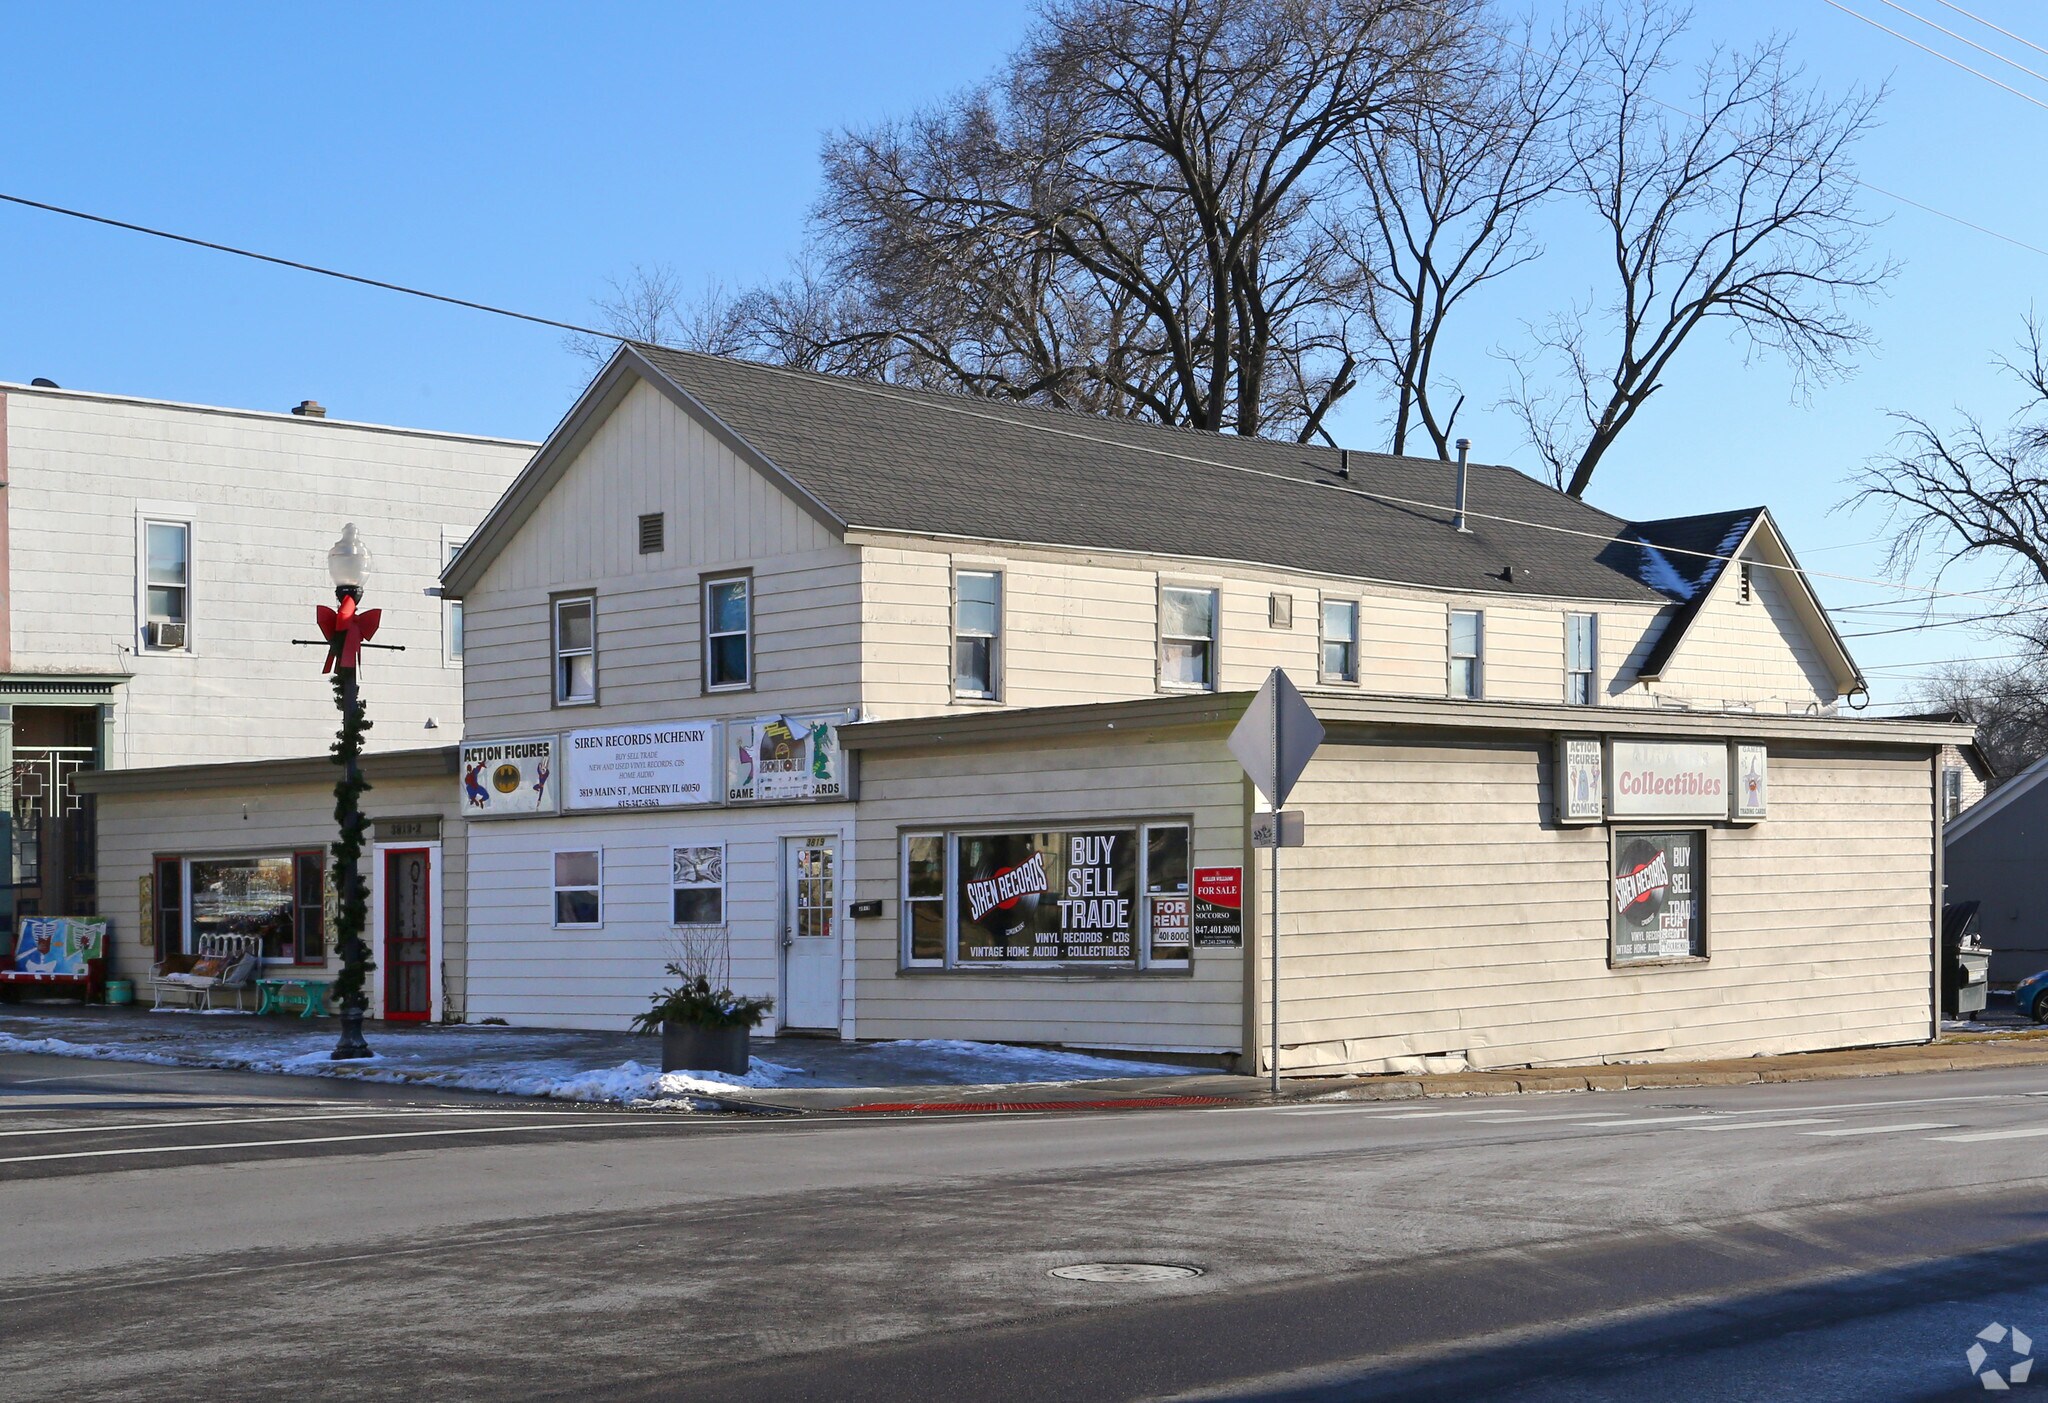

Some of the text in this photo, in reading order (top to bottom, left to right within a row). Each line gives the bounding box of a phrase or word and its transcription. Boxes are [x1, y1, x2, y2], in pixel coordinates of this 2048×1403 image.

[575, 730, 706, 749] SIREN RECORDS MCHENRY
[464, 742, 550, 762] ACTION FIGURES
[615, 751, 658, 761] BUY SELL TRADE
[1568, 742, 1600, 765] ACTION FIGURES
[602, 763, 614, 771] AND
[615, 762, 630, 770] USED
[630, 761, 646, 769] VINYL
[637, 771, 654, 779] AUDIO
[579, 788, 593, 797] 3819
[595, 787, 616, 797] MAIN
[632, 784, 670, 795] MCHENRY
[671, 784, 680, 793] IL
[681, 783, 701, 792] 60050
[812, 783, 840, 795] ARDS
[1619, 771, 1721, 796] Collectibles
[1571, 803, 1599, 814] COMICS
[806, 837, 825, 847] 3819
[1071, 835, 1116, 866] BUY
[1673, 847, 1691, 866] BUY
[967, 852, 1047, 920] SIREN RECORDS
[1067, 867, 1119, 898] SELL
[1615, 851, 1669, 913] SIREN RECORDS
[1672, 873, 1692, 894] SELL
[1198, 886, 1238, 895] FOR SALE
[1156, 901, 1186, 914] FOR
[1196, 903, 1212, 911] SAM
[1668, 899, 1696, 919] TRADE
[1057, 899, 1129, 929] TRADE
[1153, 914, 1190, 927] RENT
[1664, 917, 1684, 927] FOR
[1195, 925, 1240, 934] 847.401.8000
[1631, 931, 1644, 941] VINYL
[1035, 932, 1130, 943] VINYL RECORDS CDs
[970, 946, 1130, 957] VINTAGE HOME AUDIO COLLECTIBLES
[1633, 943, 1647, 953] HOME
